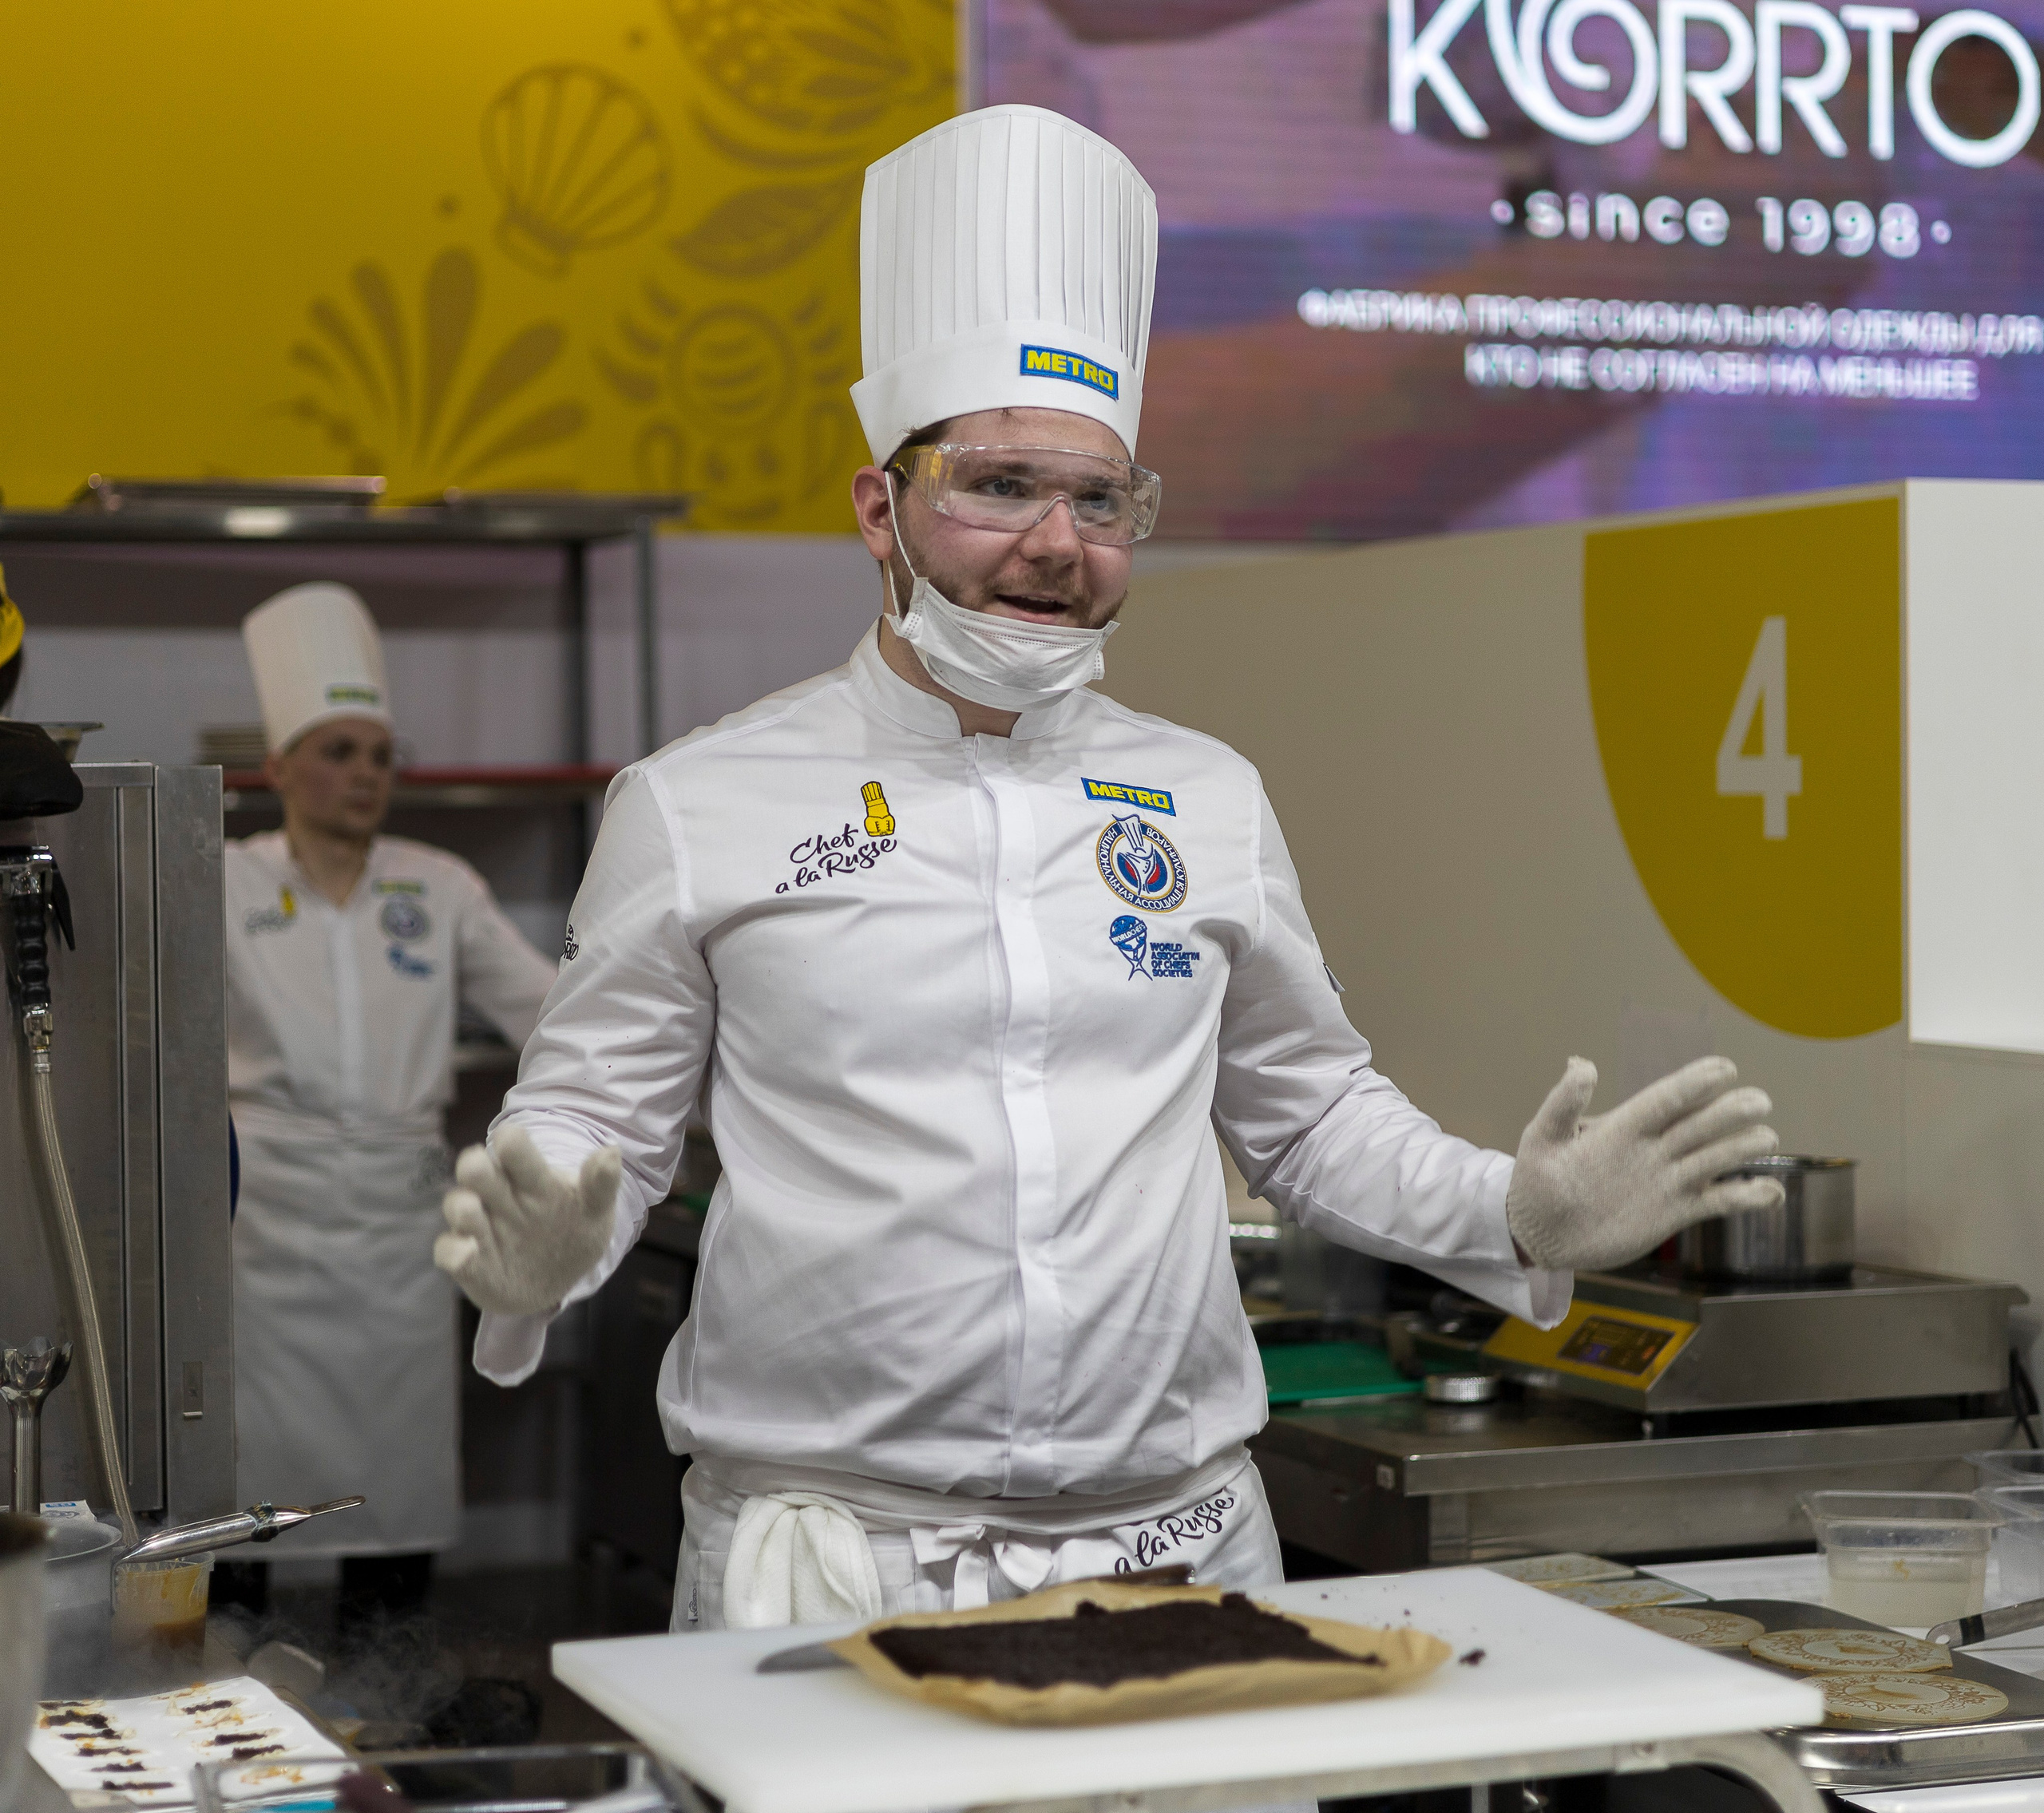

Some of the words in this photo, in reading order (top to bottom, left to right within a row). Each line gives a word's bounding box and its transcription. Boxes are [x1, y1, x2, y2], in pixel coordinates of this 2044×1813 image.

[1523, 190, 1730, 247] since
[1756, 196, 1921, 259] 1998
[1026, 350, 1115, 391] METRO
[1716, 615, 1803, 840] 4
[1087, 782, 1171, 810] METRO
[789, 823, 859, 864] Chef
[774, 881, 790, 894] a
[793, 866, 822, 888] la
[817, 837, 897, 878] Russe
[1150, 942, 1182, 952] WORLD
[1151, 960, 1163, 969] OF
[1135, 1530, 1170, 1567] la
[1156, 1497, 1234, 1546] Russe
